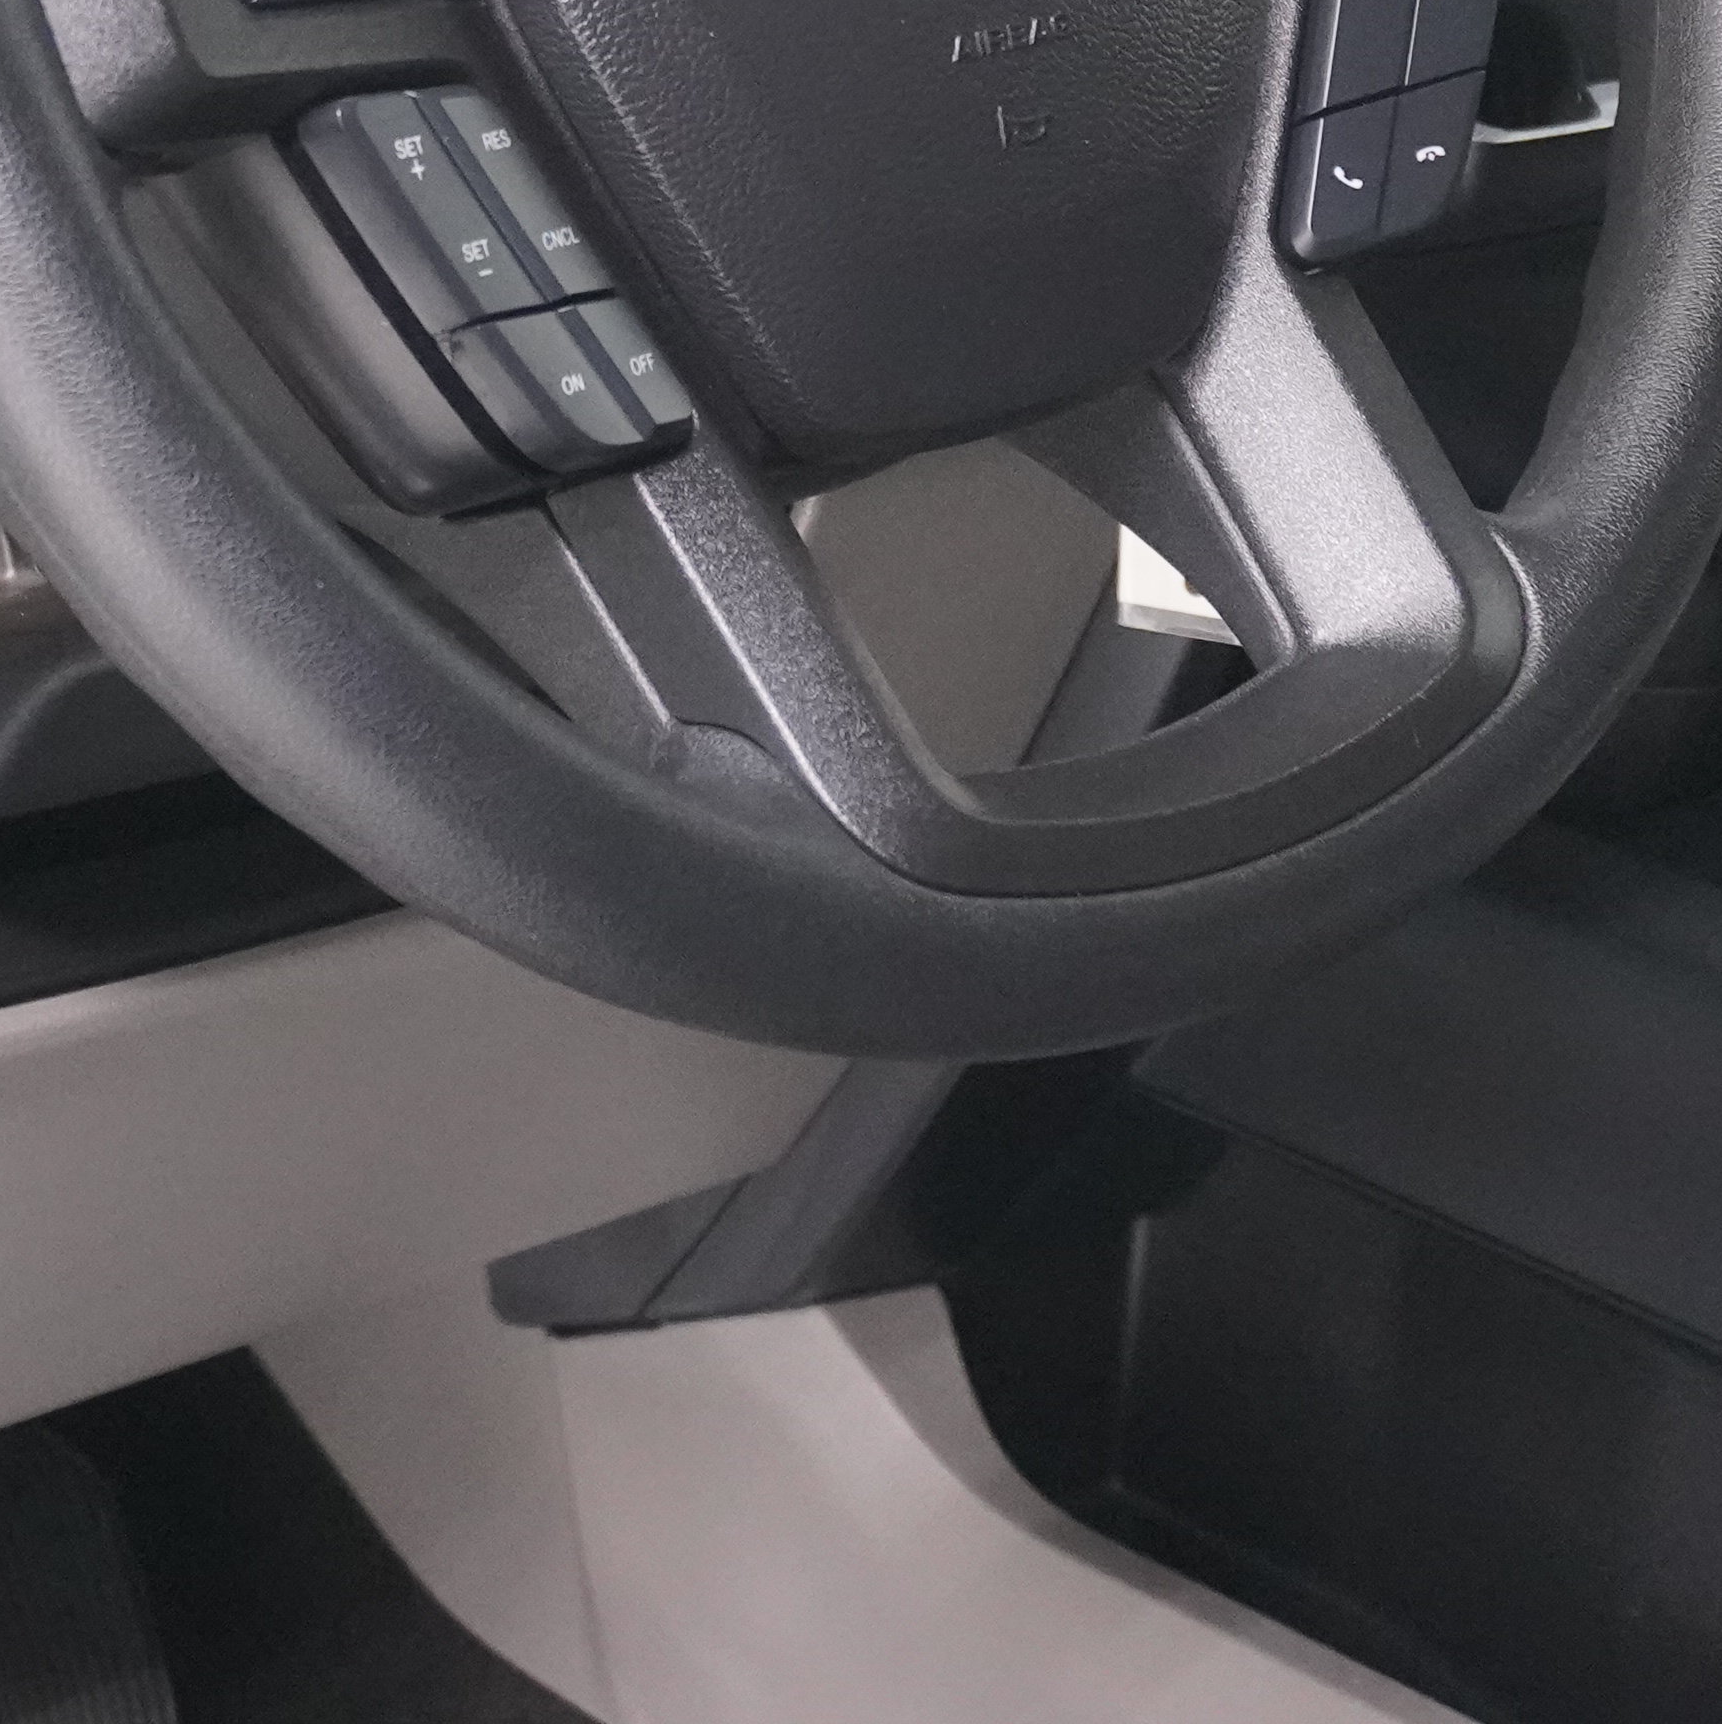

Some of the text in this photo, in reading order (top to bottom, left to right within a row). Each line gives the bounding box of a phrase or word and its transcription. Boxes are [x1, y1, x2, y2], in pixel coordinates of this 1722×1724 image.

[394, 133, 425, 160] SET
[482, 128, 512, 152] RES
[461, 238, 491, 264] SET
[541, 226, 581, 252] CNCL
[629, 352, 655, 376] OFF
[560, 372, 586, 396] ON
